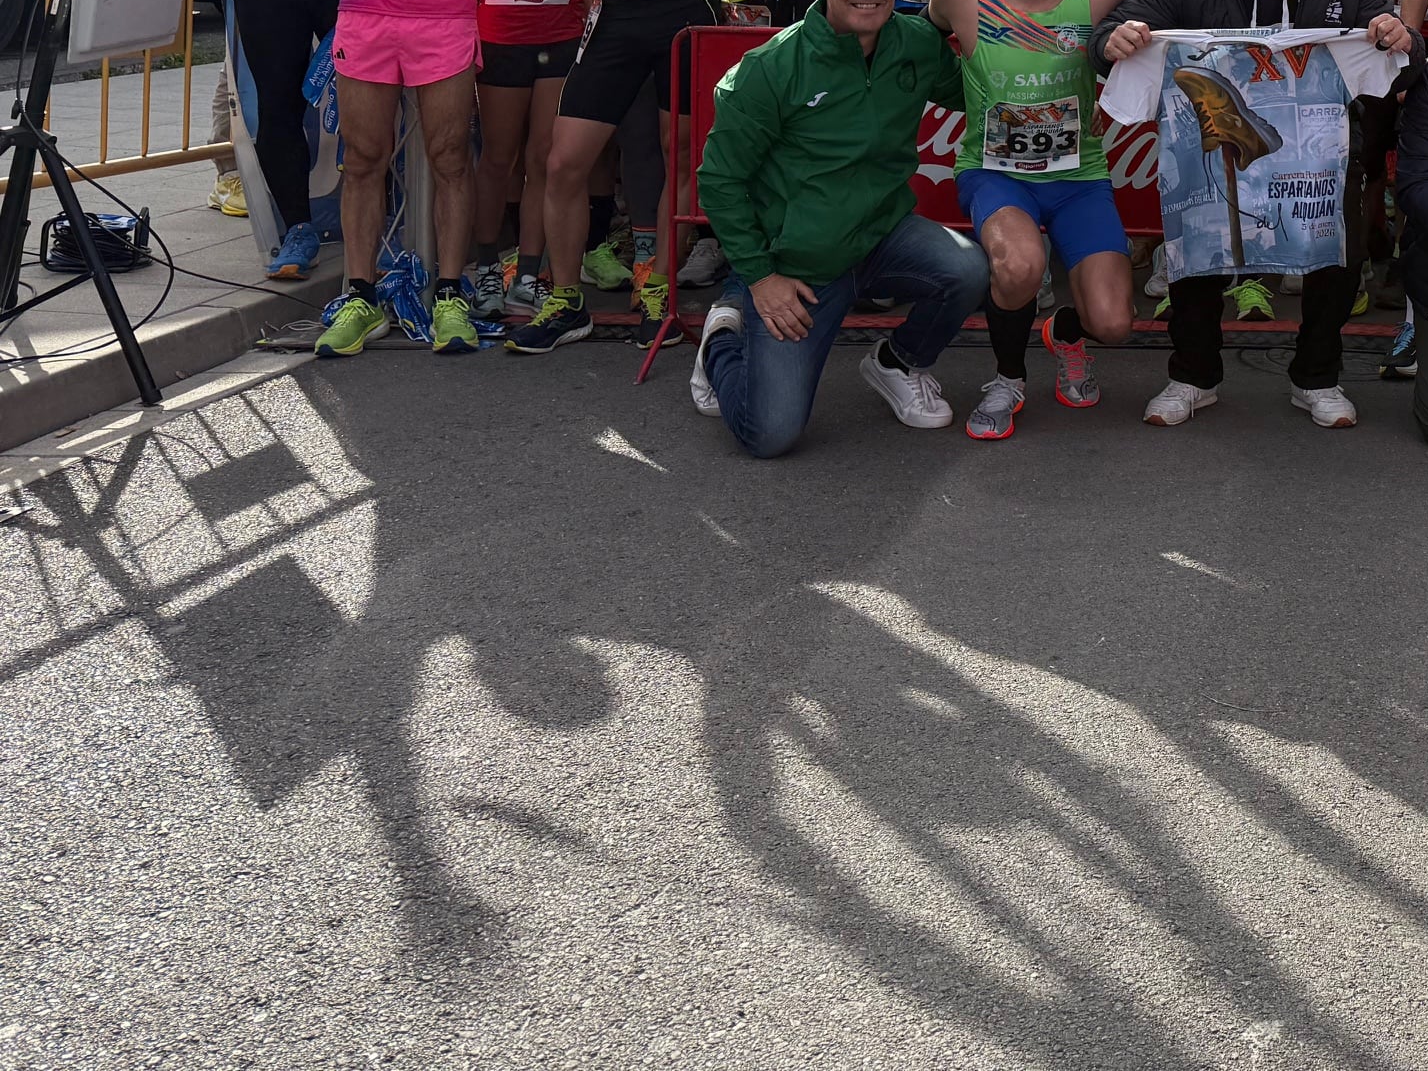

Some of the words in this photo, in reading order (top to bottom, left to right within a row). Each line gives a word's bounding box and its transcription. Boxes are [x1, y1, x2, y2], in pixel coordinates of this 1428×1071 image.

[1247, 44, 1313, 83] XV
[1014, 68, 1081, 87] SAKATA
[1010, 130, 1076, 154] 693
[1272, 171, 1305, 180] Carrera
[1305, 169, 1336, 182] Popular
[1268, 179, 1336, 199] ESPARTANOS
[1291, 196, 1336, 222] ALQUIÁN
[1315, 229, 1335, 239] 2026
